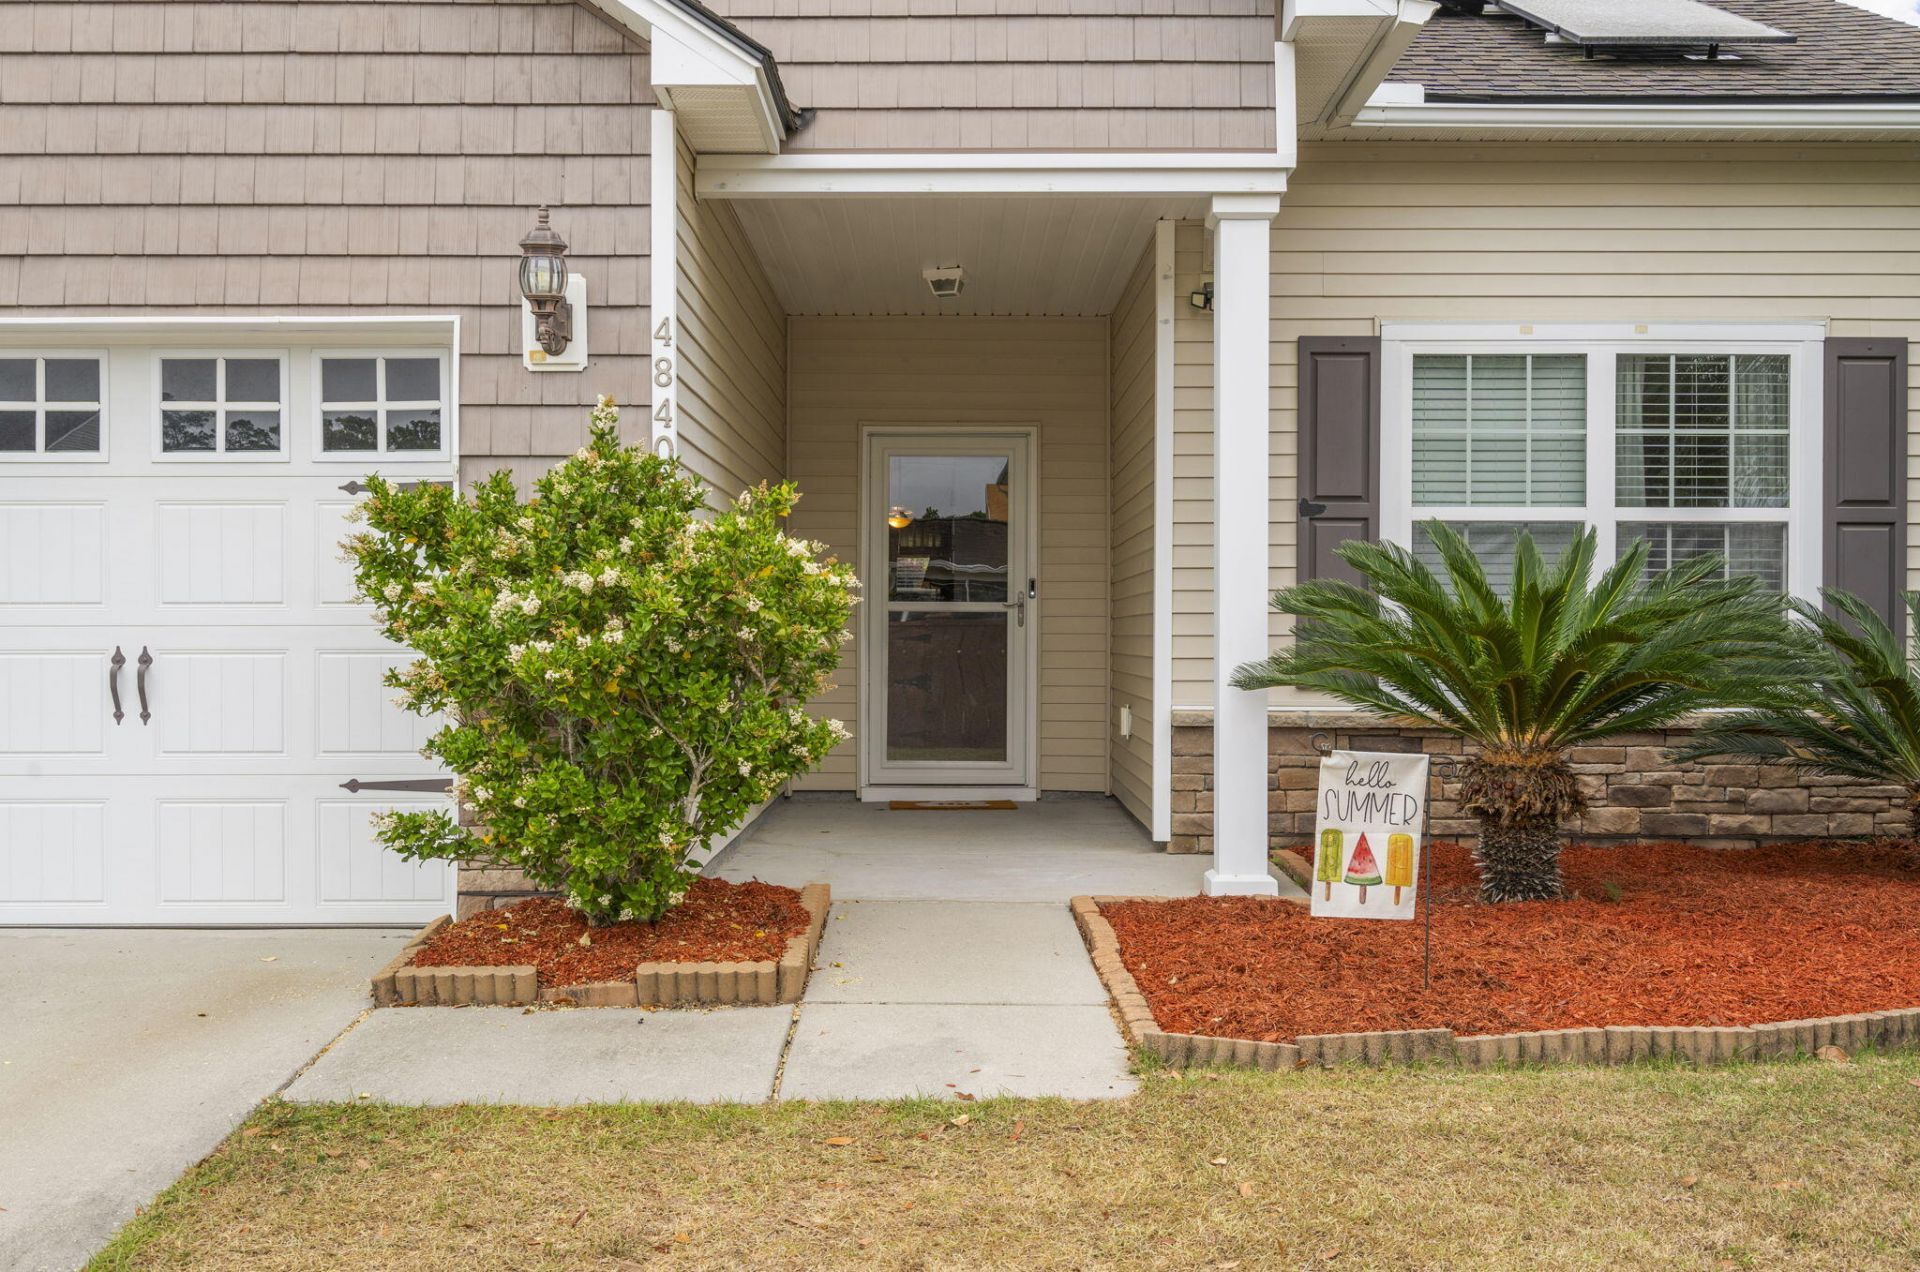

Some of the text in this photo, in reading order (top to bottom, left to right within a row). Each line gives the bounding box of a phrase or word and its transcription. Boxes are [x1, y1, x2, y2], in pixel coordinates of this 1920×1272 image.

[653, 316, 674, 461] 4840
[1345, 760, 1397, 789] hello
[1324, 788, 1418, 826] SUMMER
